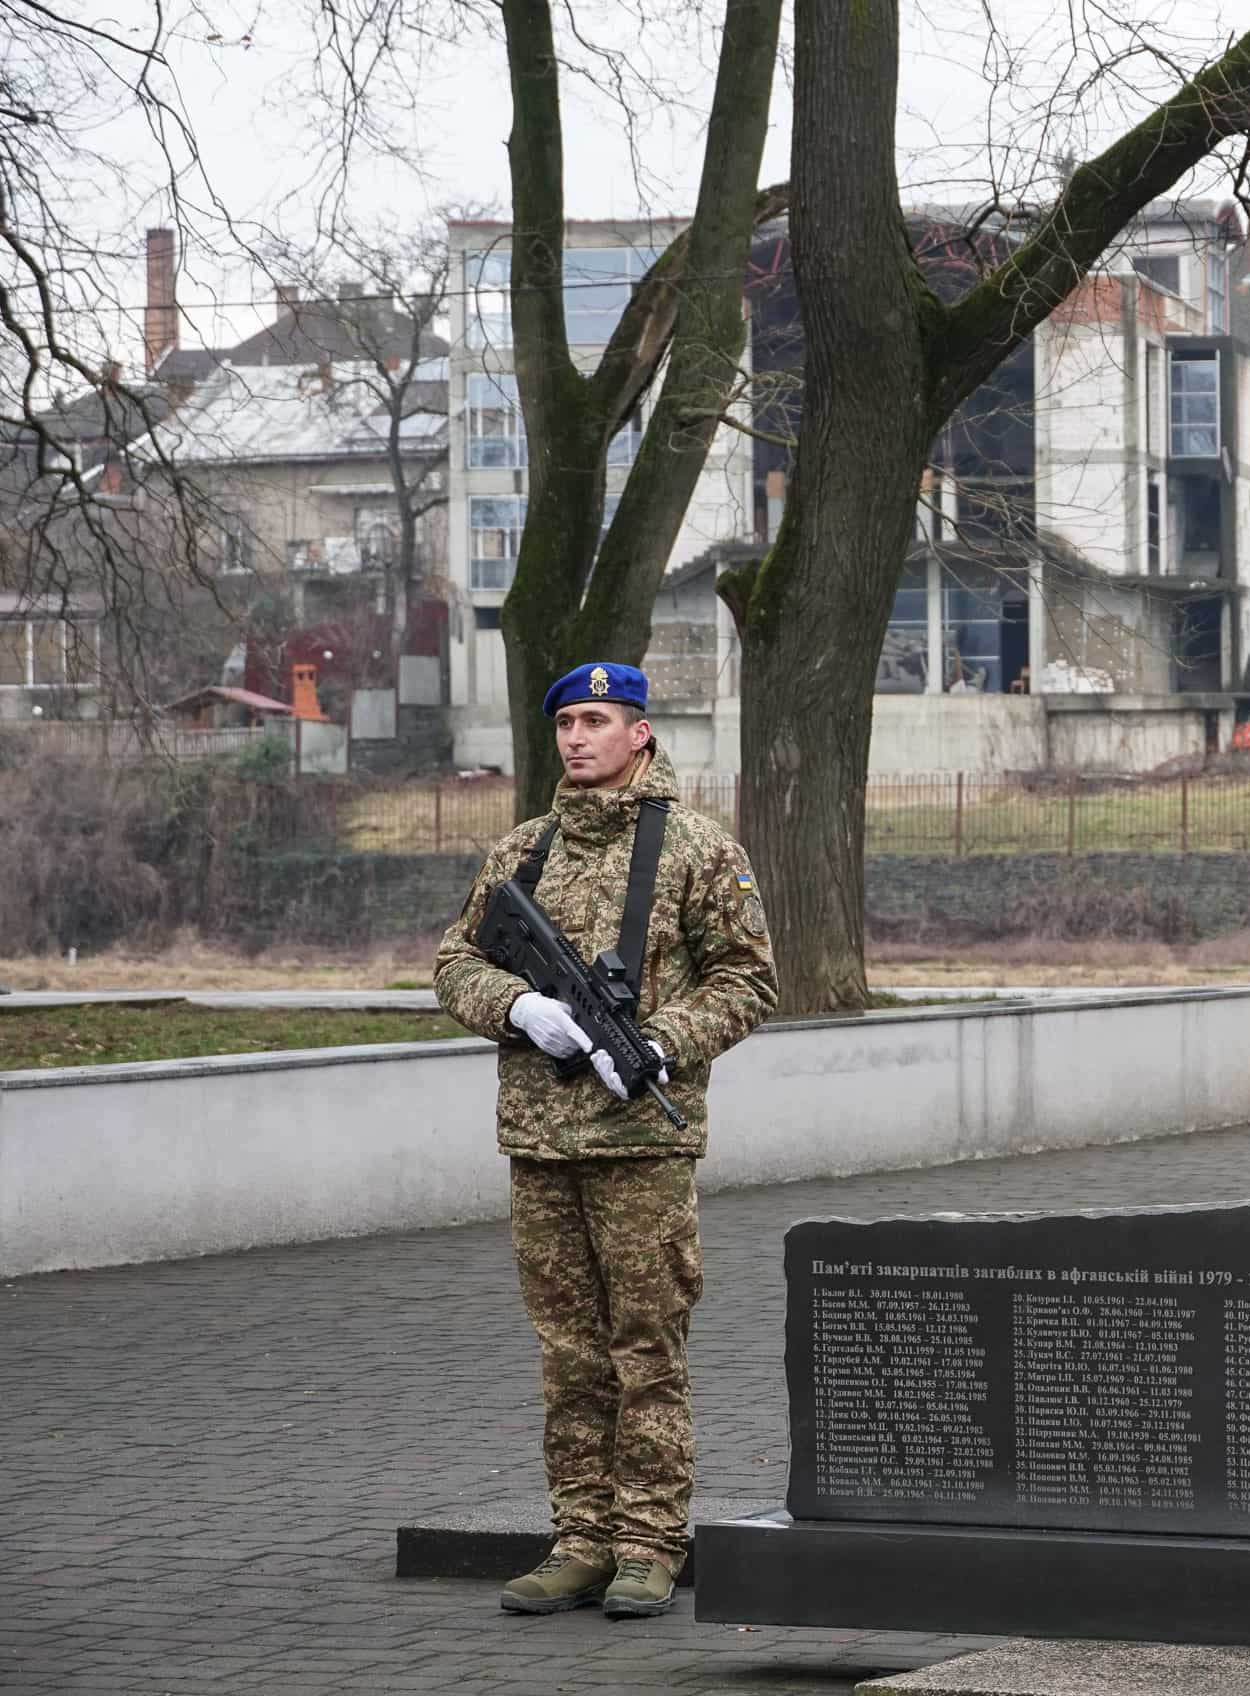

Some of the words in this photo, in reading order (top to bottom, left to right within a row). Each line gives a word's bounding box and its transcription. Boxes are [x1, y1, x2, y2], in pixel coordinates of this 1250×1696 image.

[811, 1260, 872, 1275] Пам'яті
[876, 1263, 969, 1280] закарпатців
[973, 1265, 1042, 1281] загиблих
[1048, 1269, 1056, 1281] в
[1061, 1267, 1149, 1285] афганській
[1154, 1269, 1193, 1285] війні
[1199, 1271, 1232, 1286] 1979
